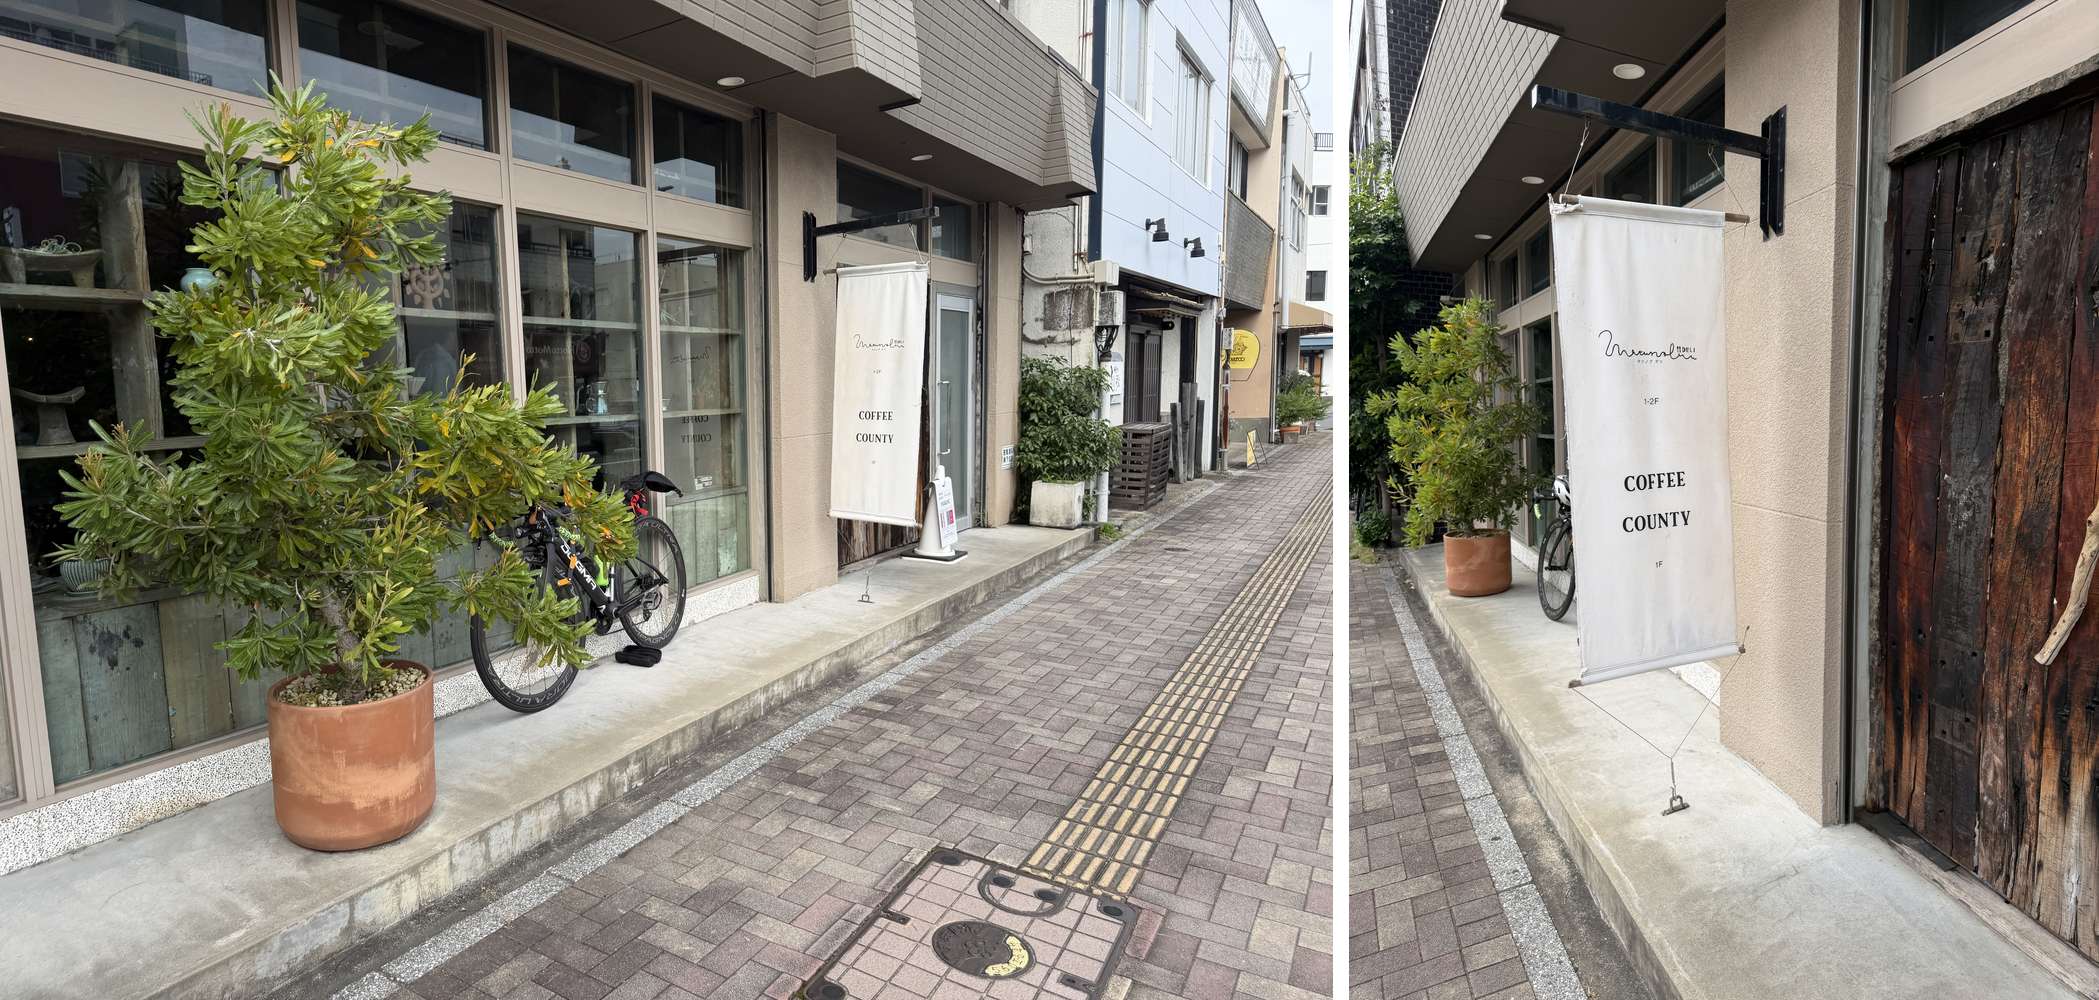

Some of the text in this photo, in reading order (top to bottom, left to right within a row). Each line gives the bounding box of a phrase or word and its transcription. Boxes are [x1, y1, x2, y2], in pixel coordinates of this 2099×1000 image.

[1643, 397, 1660, 405] 1-2F
[858, 410, 894, 421] COFFEE
[856, 432, 894, 444] COUNTY
[1623, 471, 1686, 492] COFFEE
[1622, 510, 1691, 533] COUNTY
